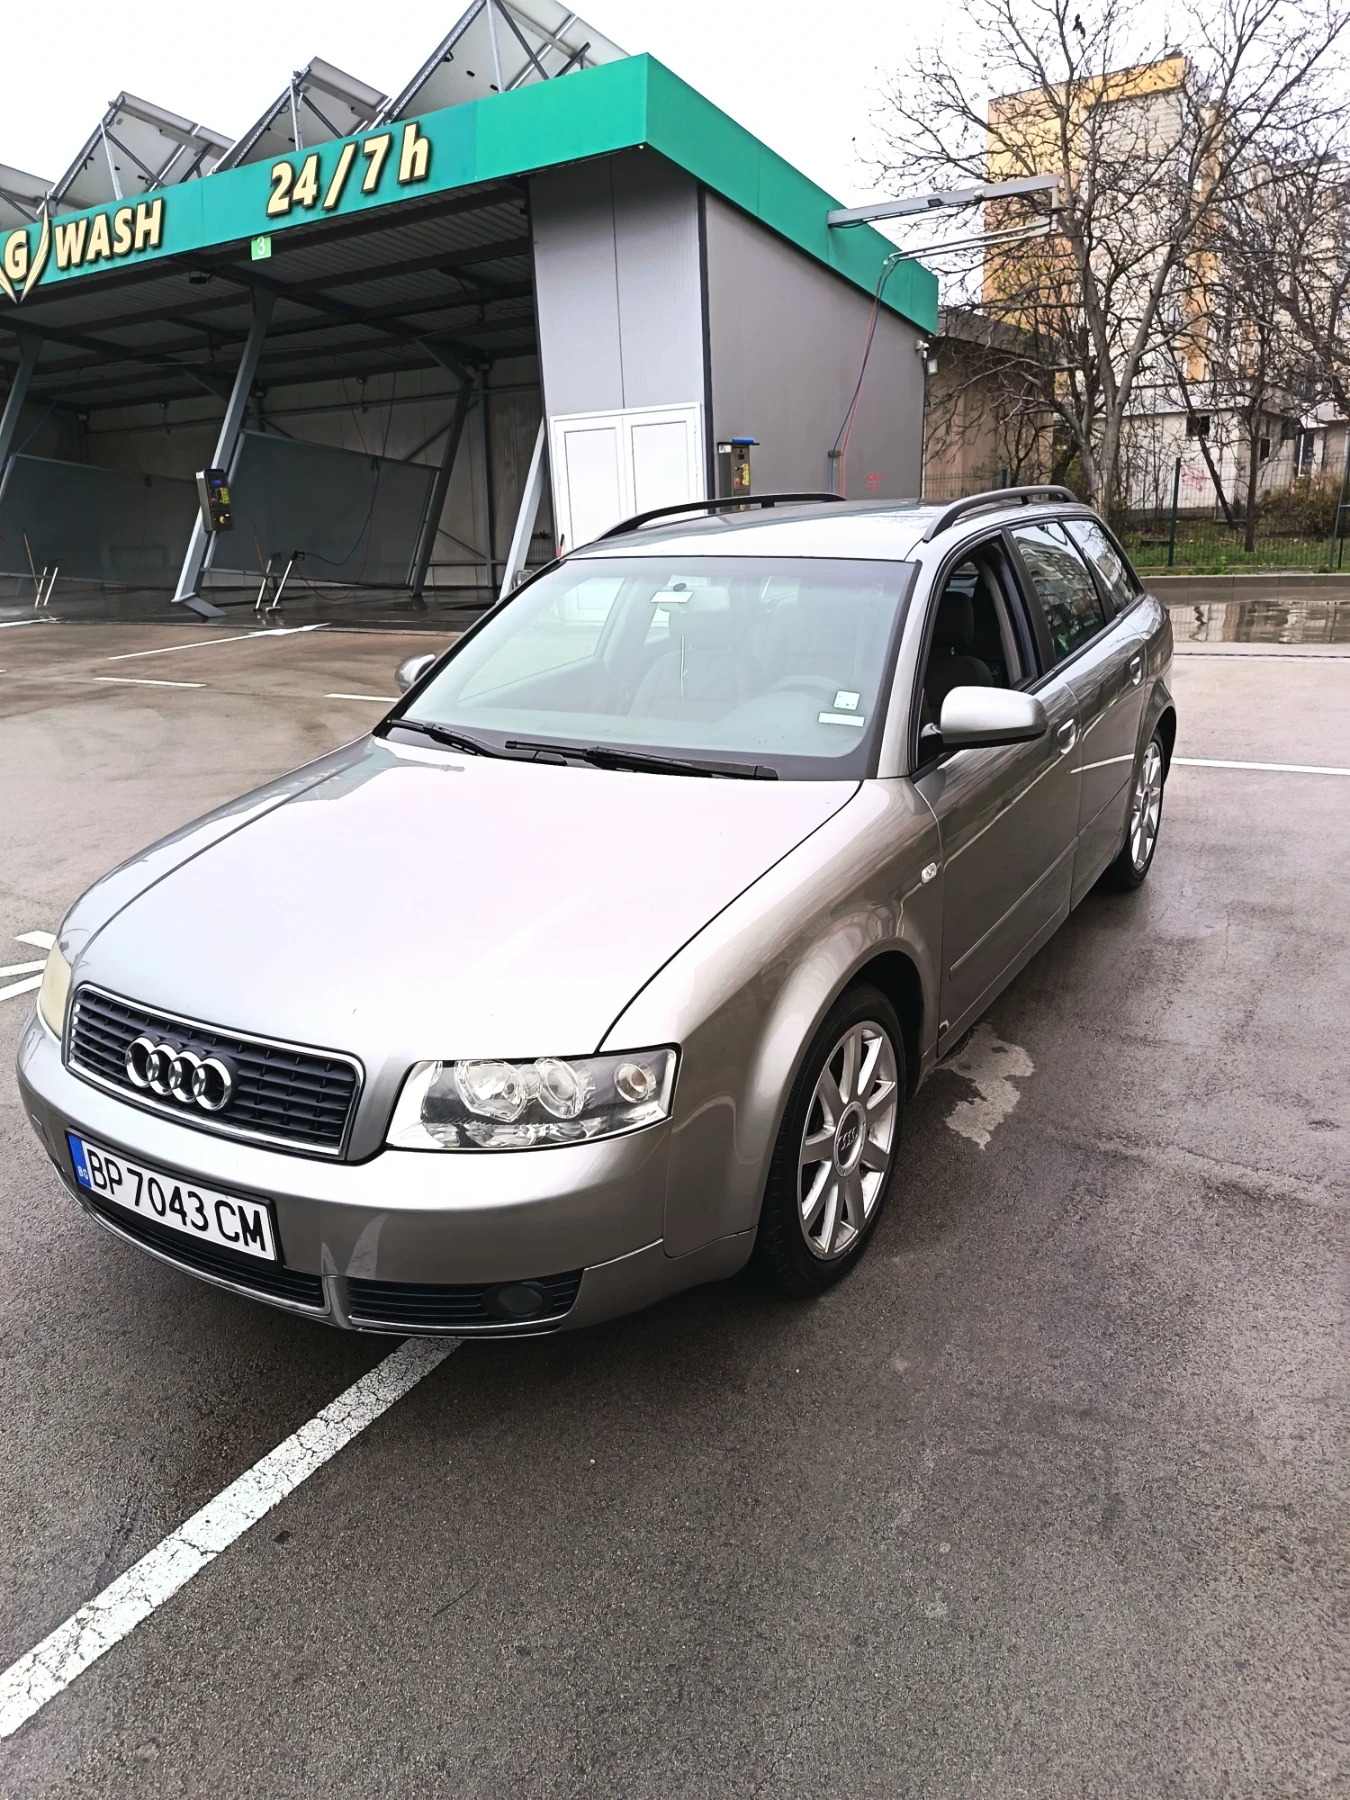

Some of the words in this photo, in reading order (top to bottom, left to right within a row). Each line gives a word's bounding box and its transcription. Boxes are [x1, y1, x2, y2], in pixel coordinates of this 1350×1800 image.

[54, 197, 163, 269] WASH
[257, 236, 266, 256] 3
[77, 1165, 89, 1180] BG
[87, 1148, 123, 1195] BP
[126, 1167, 209, 1232] 7043
[214, 1200, 266, 1252] CM
